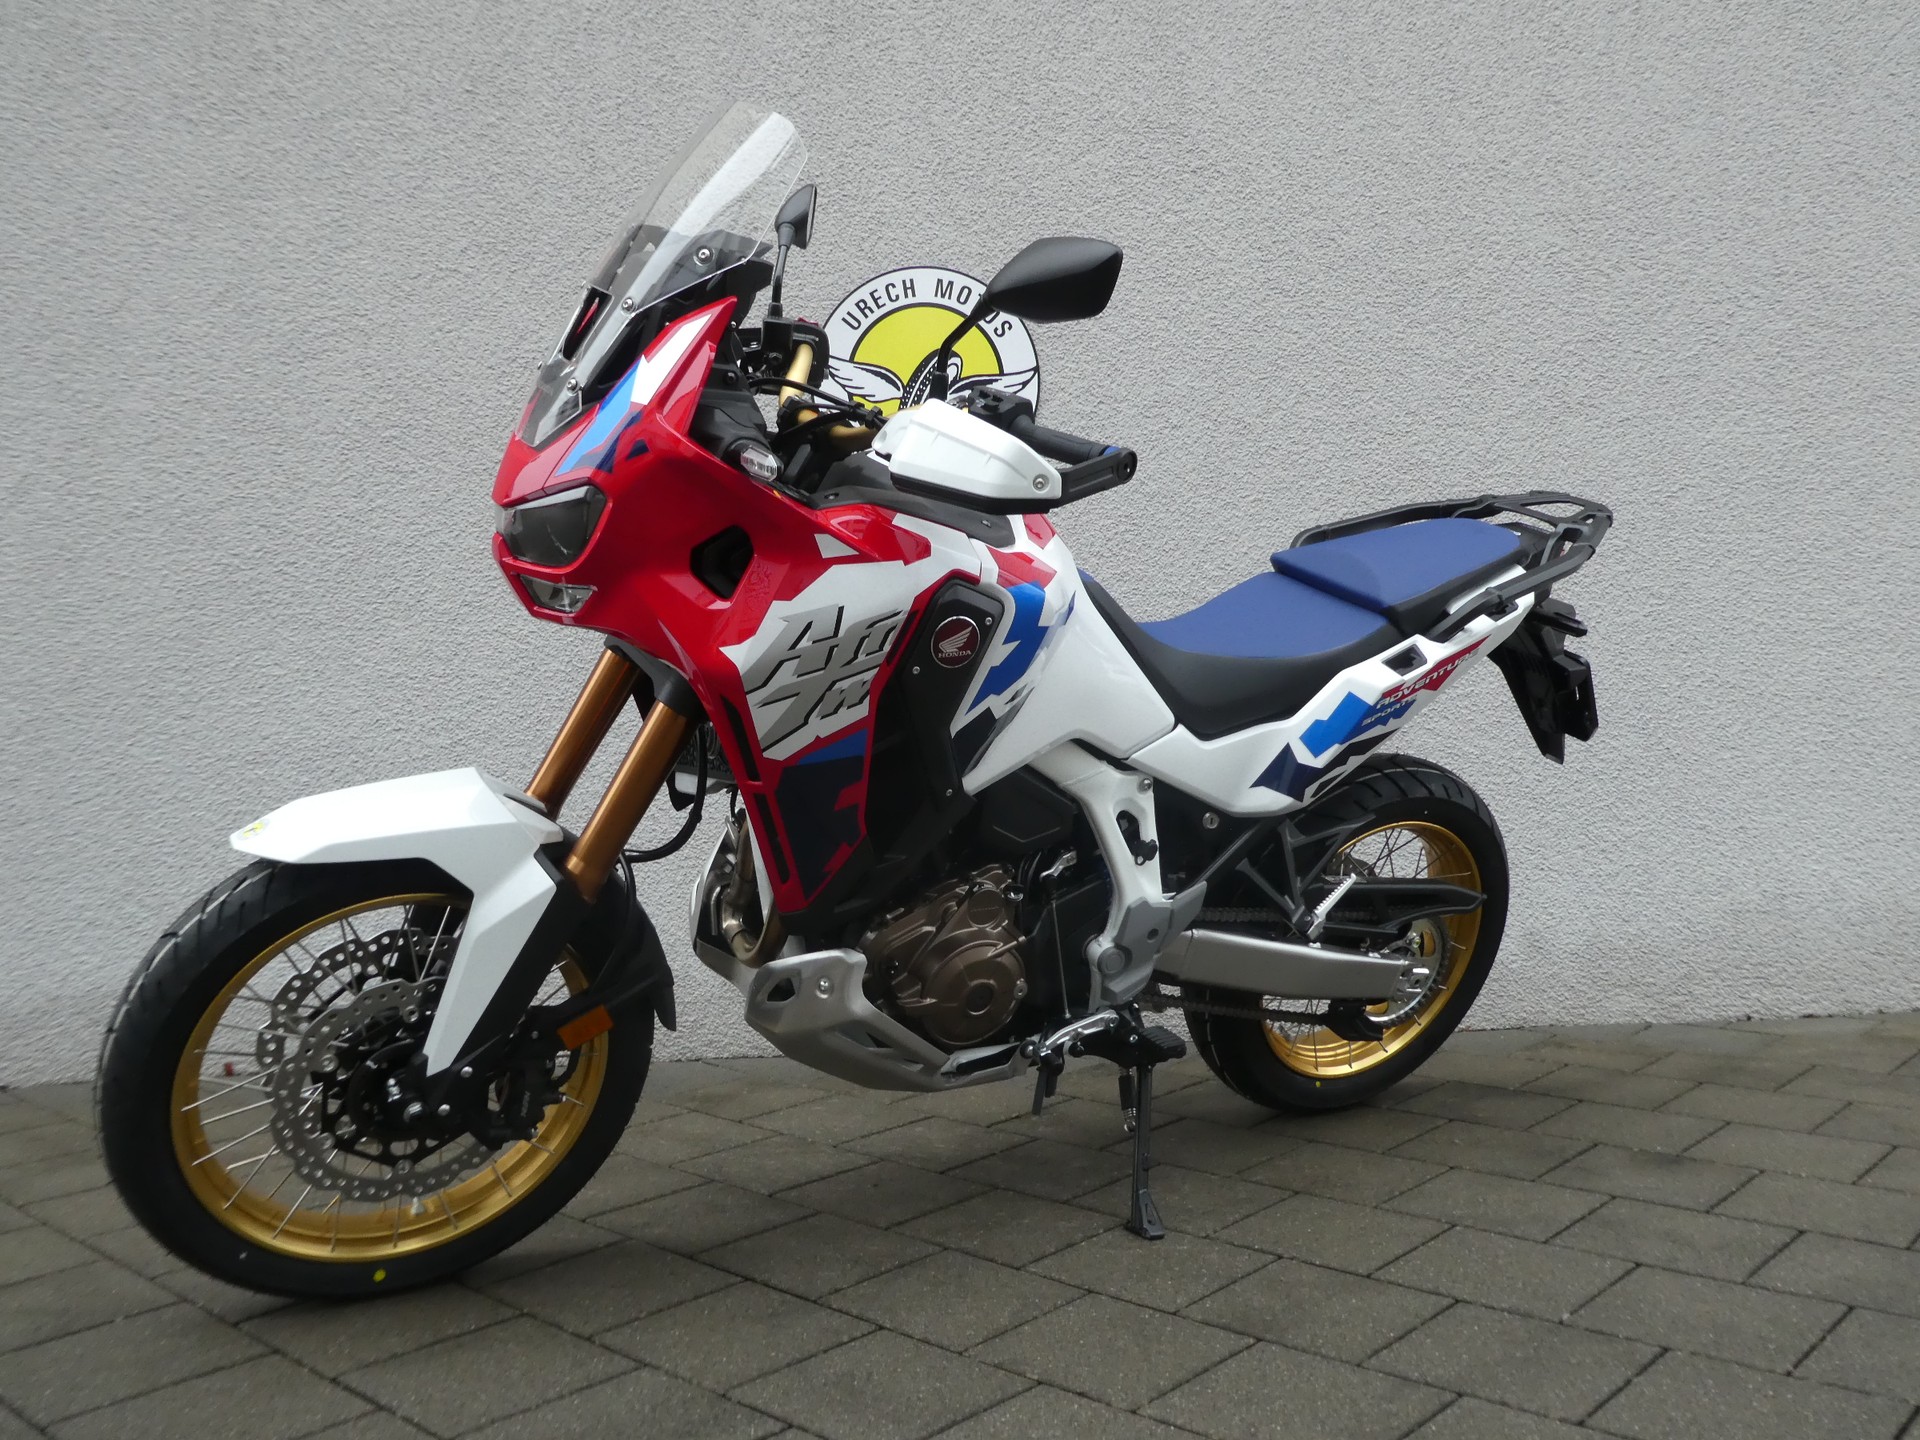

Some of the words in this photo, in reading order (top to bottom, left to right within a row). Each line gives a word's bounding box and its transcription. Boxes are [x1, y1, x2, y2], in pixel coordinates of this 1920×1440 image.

[841, 278, 916, 331] URECH
[934, 278, 1013, 338] MOOS
[937, 649, 972, 659] HONDA
[1376, 648, 1480, 709] ADVENTURE
[1361, 694, 1418, 726] SPORTS
